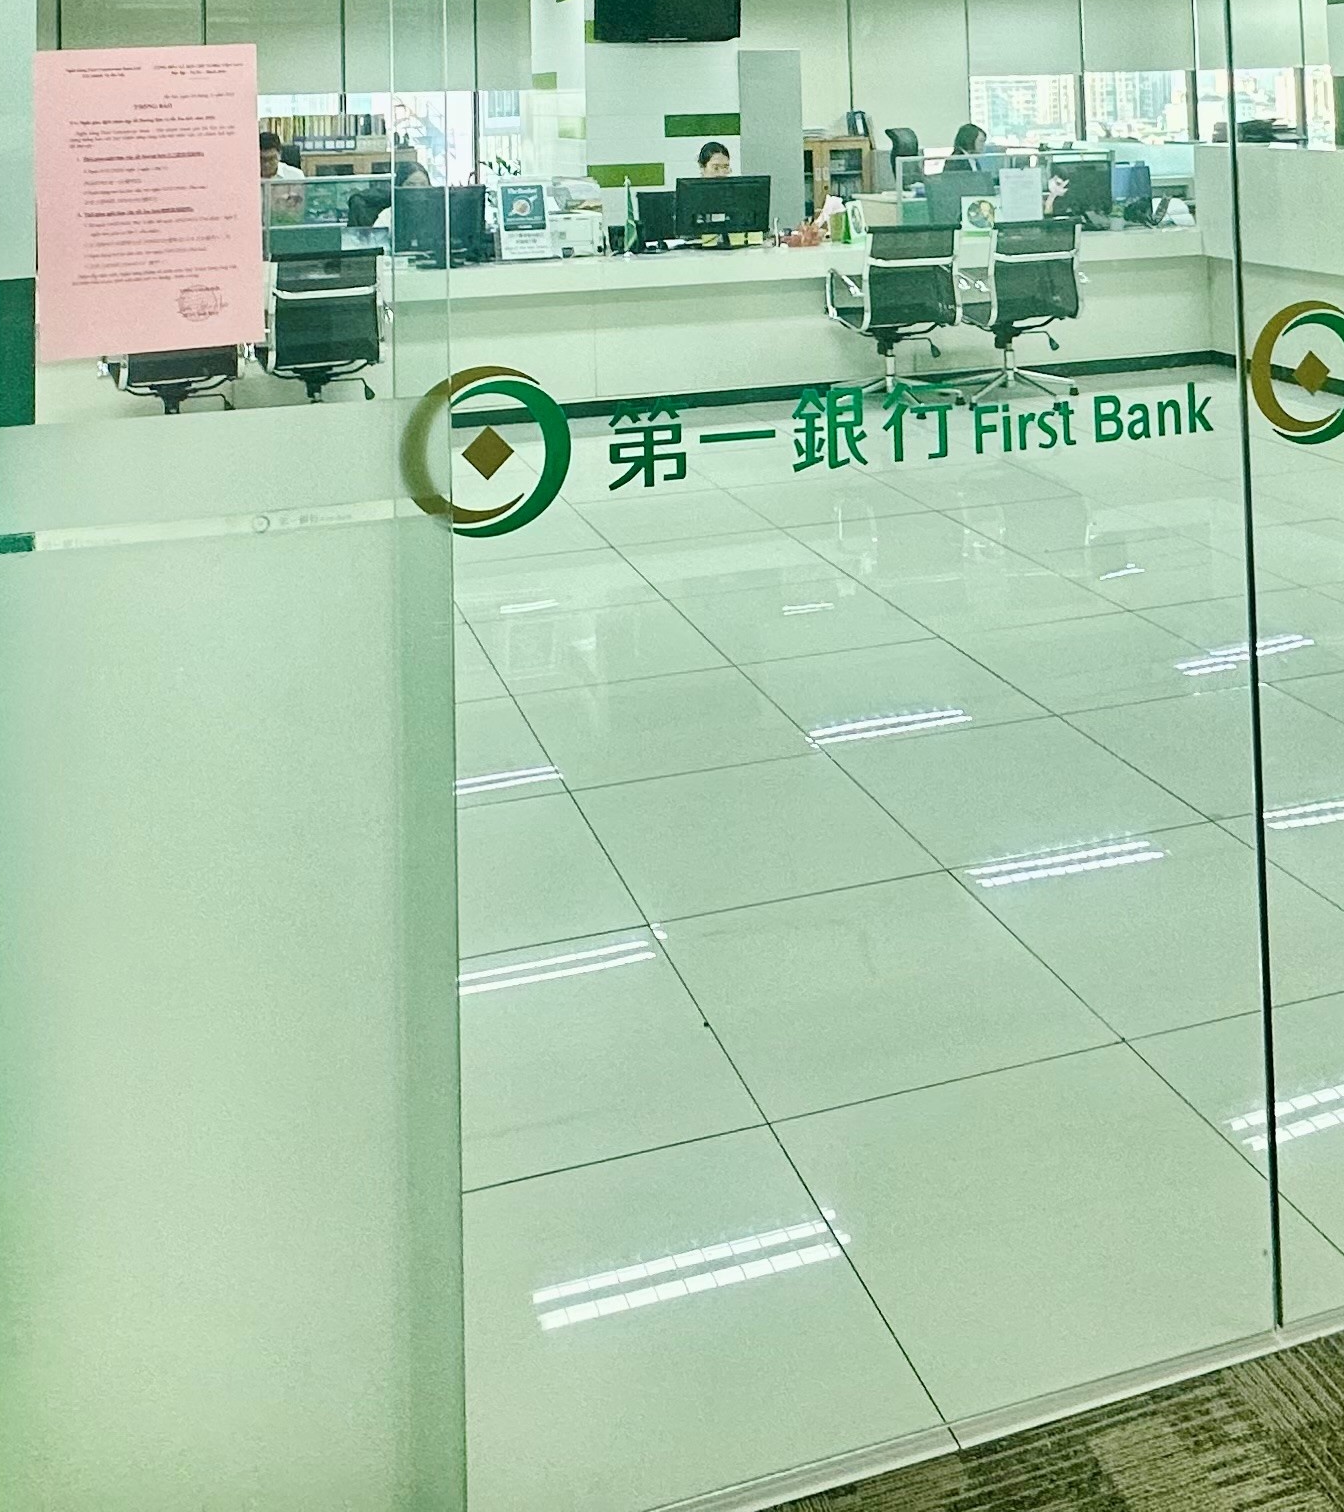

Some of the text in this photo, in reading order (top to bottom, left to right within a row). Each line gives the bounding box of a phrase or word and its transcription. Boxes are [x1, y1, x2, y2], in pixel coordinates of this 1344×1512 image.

[607, 383, 1215, 491] 第一銀行 First Bank
